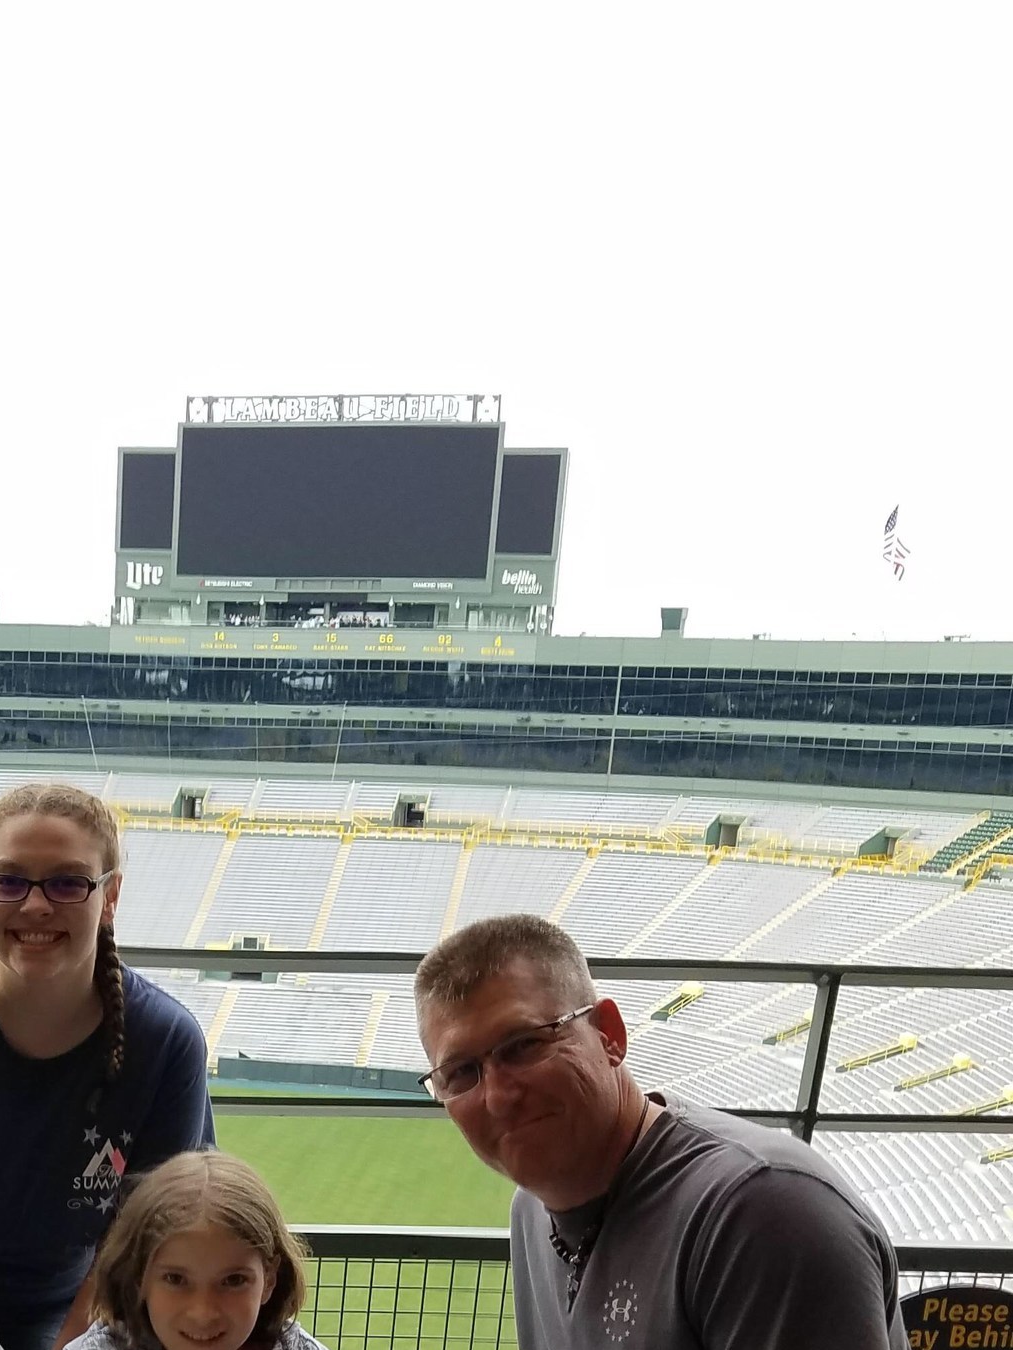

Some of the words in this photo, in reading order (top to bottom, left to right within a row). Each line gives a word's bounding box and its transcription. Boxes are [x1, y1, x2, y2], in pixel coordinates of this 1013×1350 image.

[224, 396, 362, 421] LAMBEAU
[373, 395, 460, 420] FIELD
[126, 561, 164, 590] Lite
[501, 569, 537, 586] bellin
[514, 582, 543, 595] health
[213, 631, 226, 641] 14
[272, 632, 279, 642] 3
[326, 632, 337, 643] 15
[379, 634, 394, 643] 66
[922, 1297, 1010, 1323] Please
